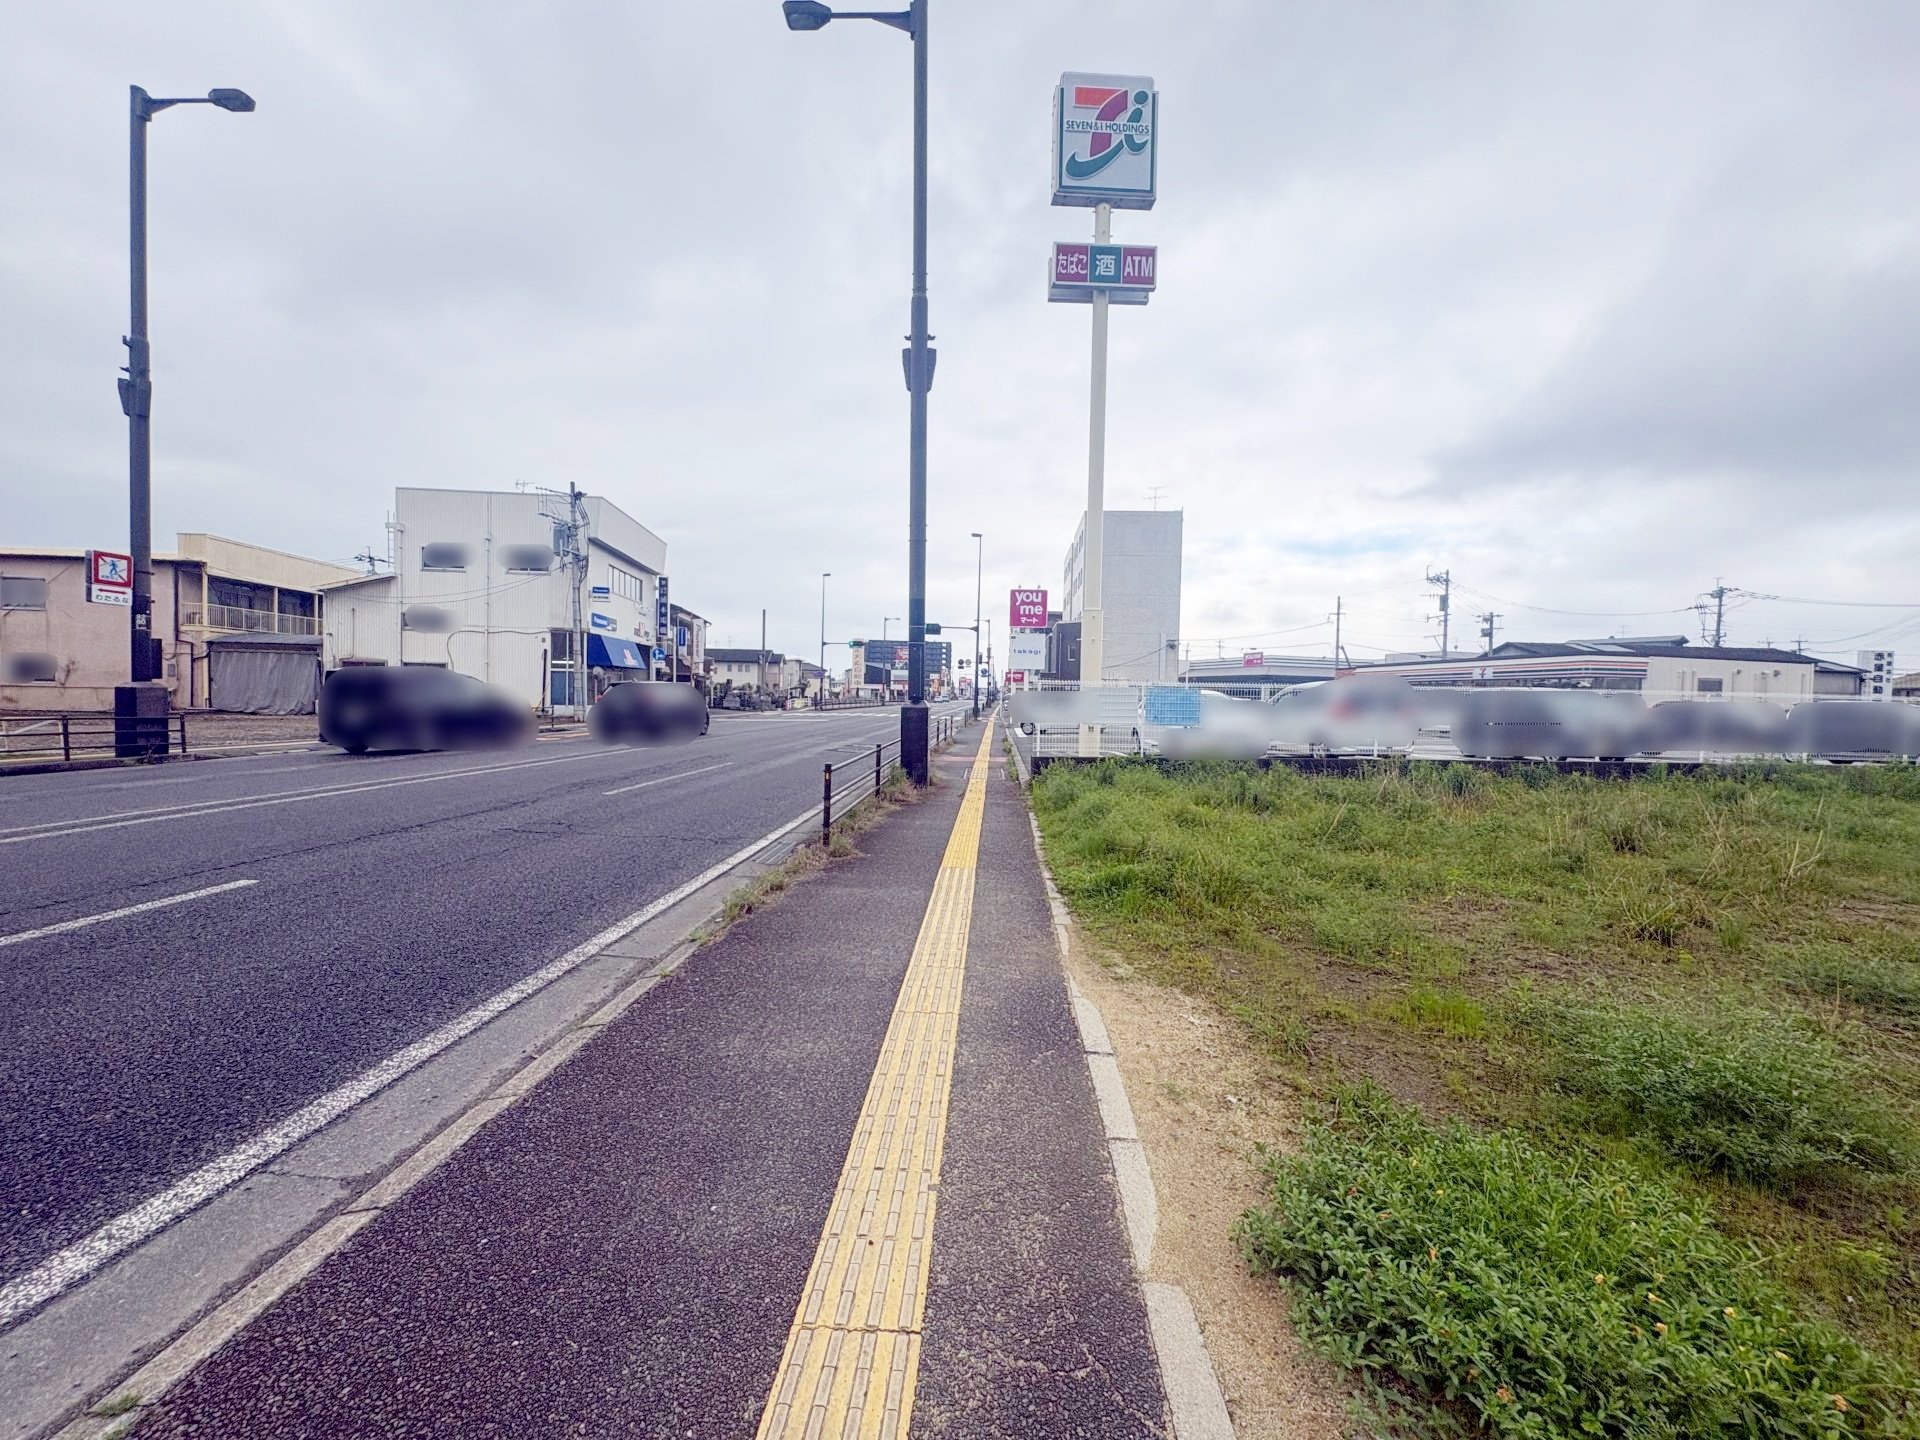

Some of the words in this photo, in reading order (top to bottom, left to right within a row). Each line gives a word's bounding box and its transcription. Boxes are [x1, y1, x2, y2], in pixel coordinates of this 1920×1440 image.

[1105, 121, 1150, 134] HOLDINGS
[1057, 252, 1088, 274] たばこ
[1095, 254, 1116, 276] 酒
[1124, 255, 1153, 277] ATM
[95, 594, 129, 604] わたるな
[1015, 591, 1042, 606] you
[1020, 605, 1043, 615] me
[1020, 616, 1038, 624] マート
